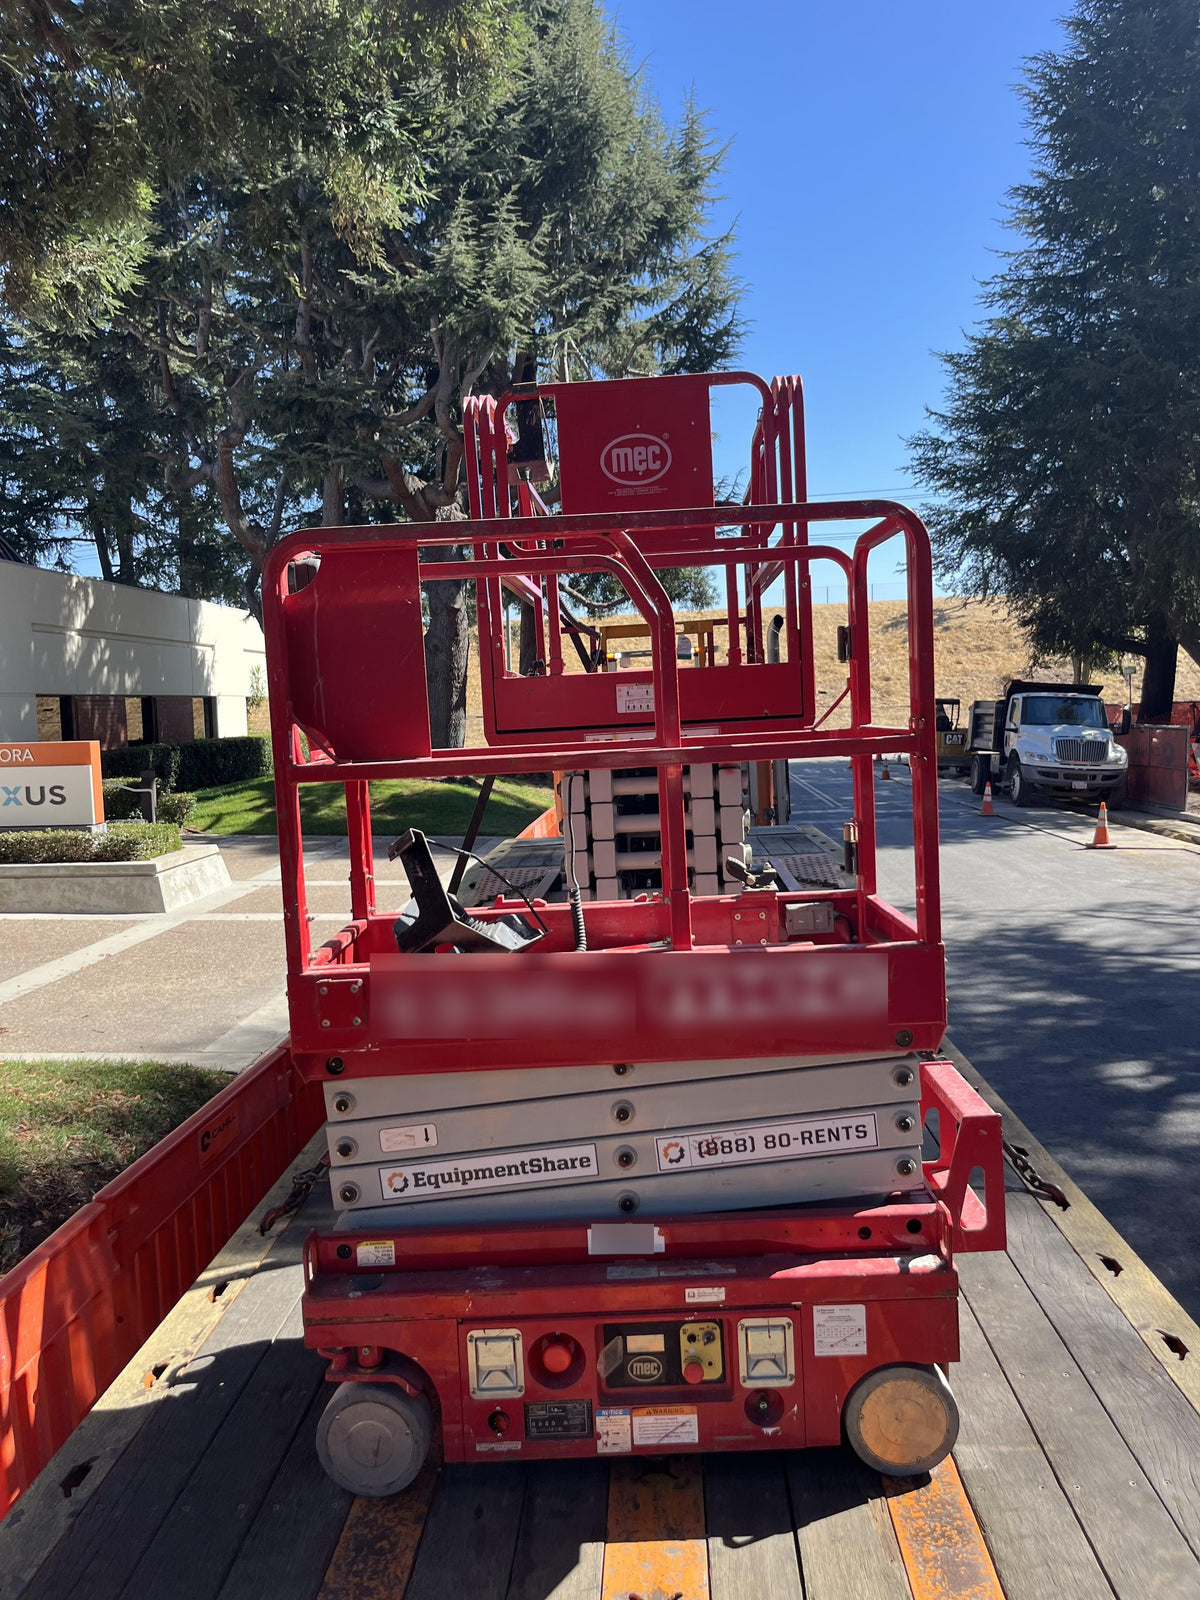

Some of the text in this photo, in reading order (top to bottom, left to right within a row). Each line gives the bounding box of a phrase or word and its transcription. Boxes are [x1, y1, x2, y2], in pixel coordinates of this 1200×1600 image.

[945, 734, 963, 745] CAT
[0, 748, 35, 763] ORA
[1, 784, 67, 806] XUS
[697, 1123, 869, 1159] (888) 80-RENTS
[412, 1155, 592, 1189] EquipmentShare
[652, 1407, 685, 1415] WARNING
